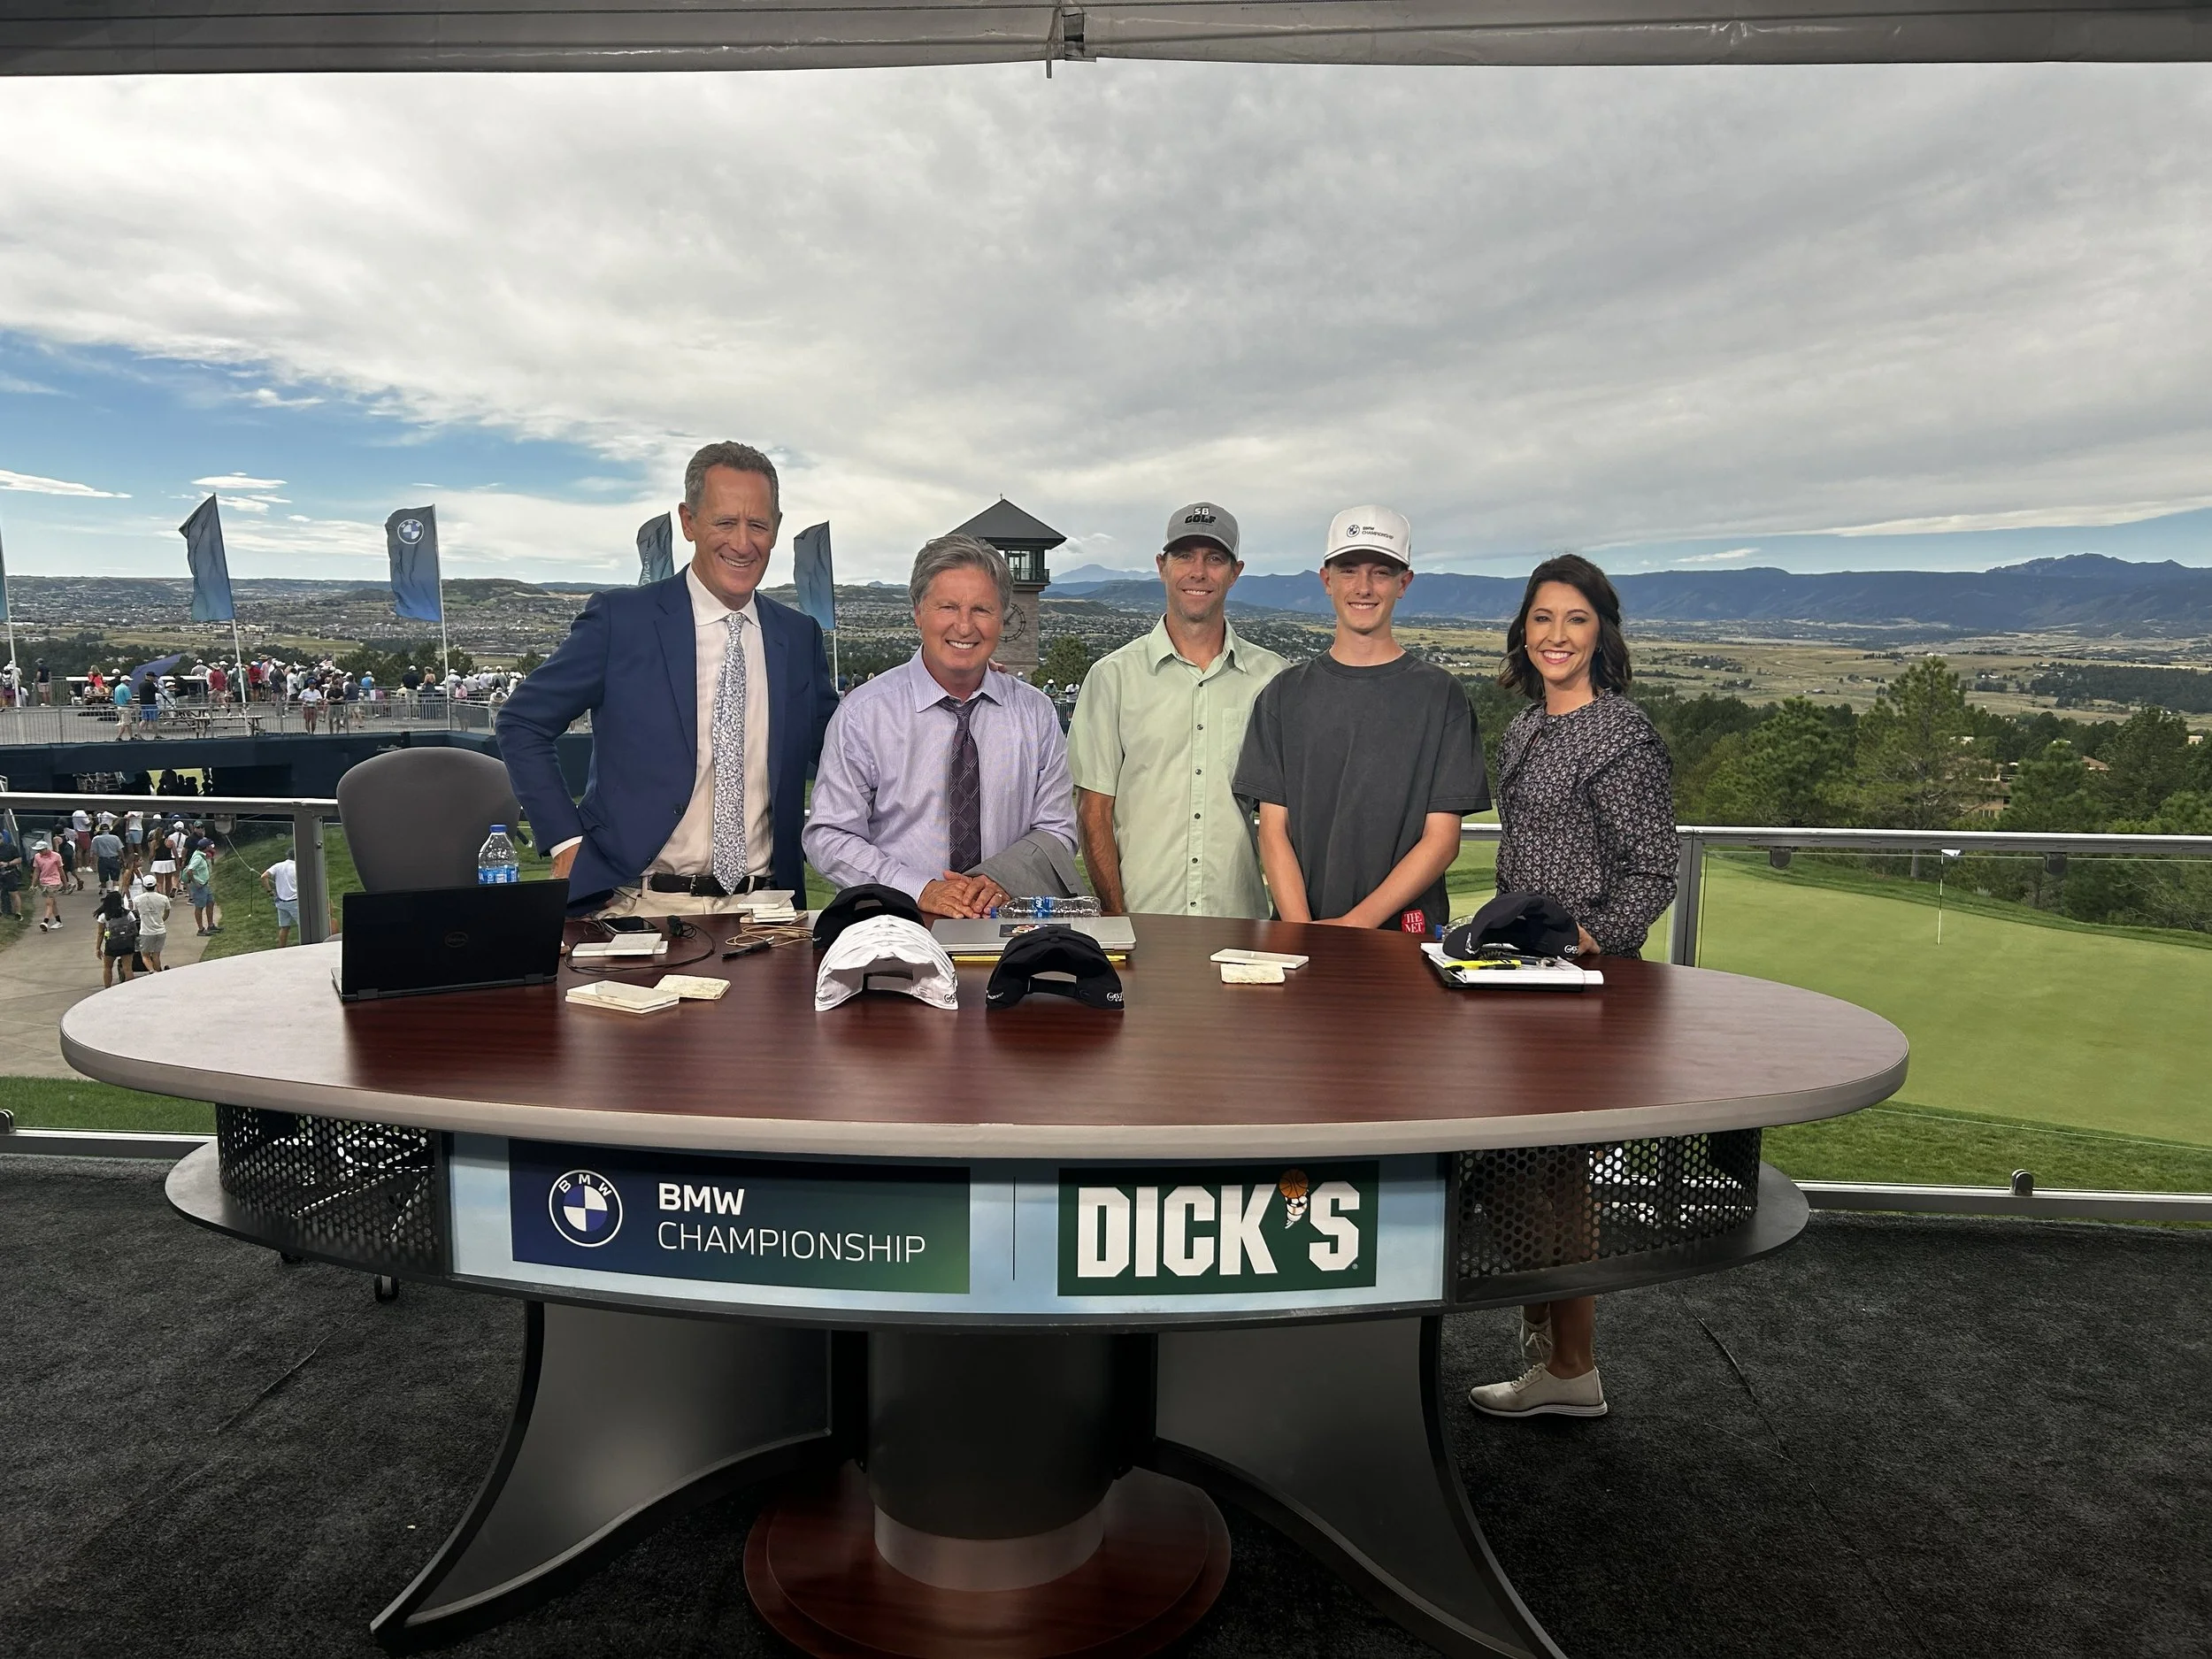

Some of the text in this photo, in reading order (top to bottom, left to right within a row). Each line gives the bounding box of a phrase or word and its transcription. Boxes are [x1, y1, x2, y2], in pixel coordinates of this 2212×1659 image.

[1185, 515, 1216, 524] GOLF
[558, 1174, 611, 1197] BMW
[658, 1182, 745, 1216] BMW
[1077, 1169, 1360, 1278] DICK'S
[657, 1221, 926, 1263] CHAMPIONSHIP
